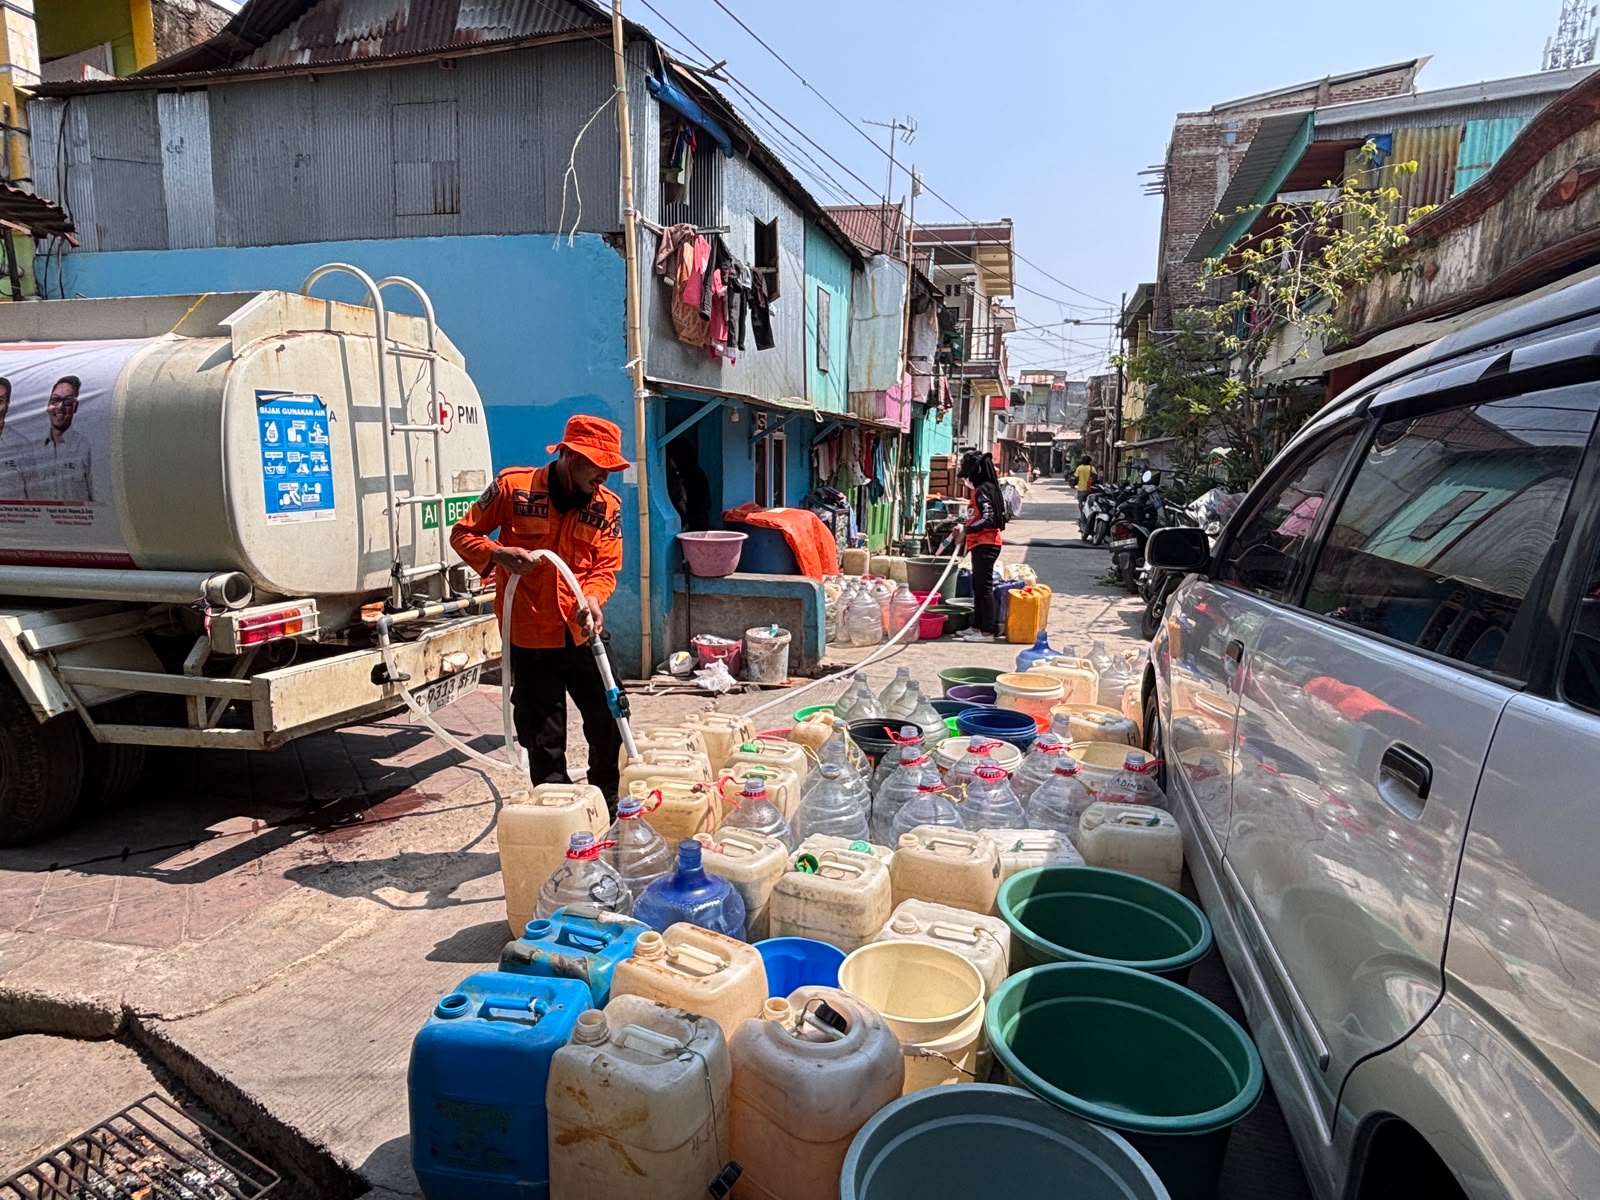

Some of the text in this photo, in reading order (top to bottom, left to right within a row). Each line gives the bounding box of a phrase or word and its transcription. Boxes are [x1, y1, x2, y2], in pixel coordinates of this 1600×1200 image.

[260, 407, 281, 415] BIJAK
[282, 408, 314, 416] GUNAKAN
[458, 406, 478, 424] PMI
[424, 504, 438, 524] AI
[740, 725, 750, 742] M
[1115, 777, 1149, 792] ADINDA
[586, 805, 599, 823] M
